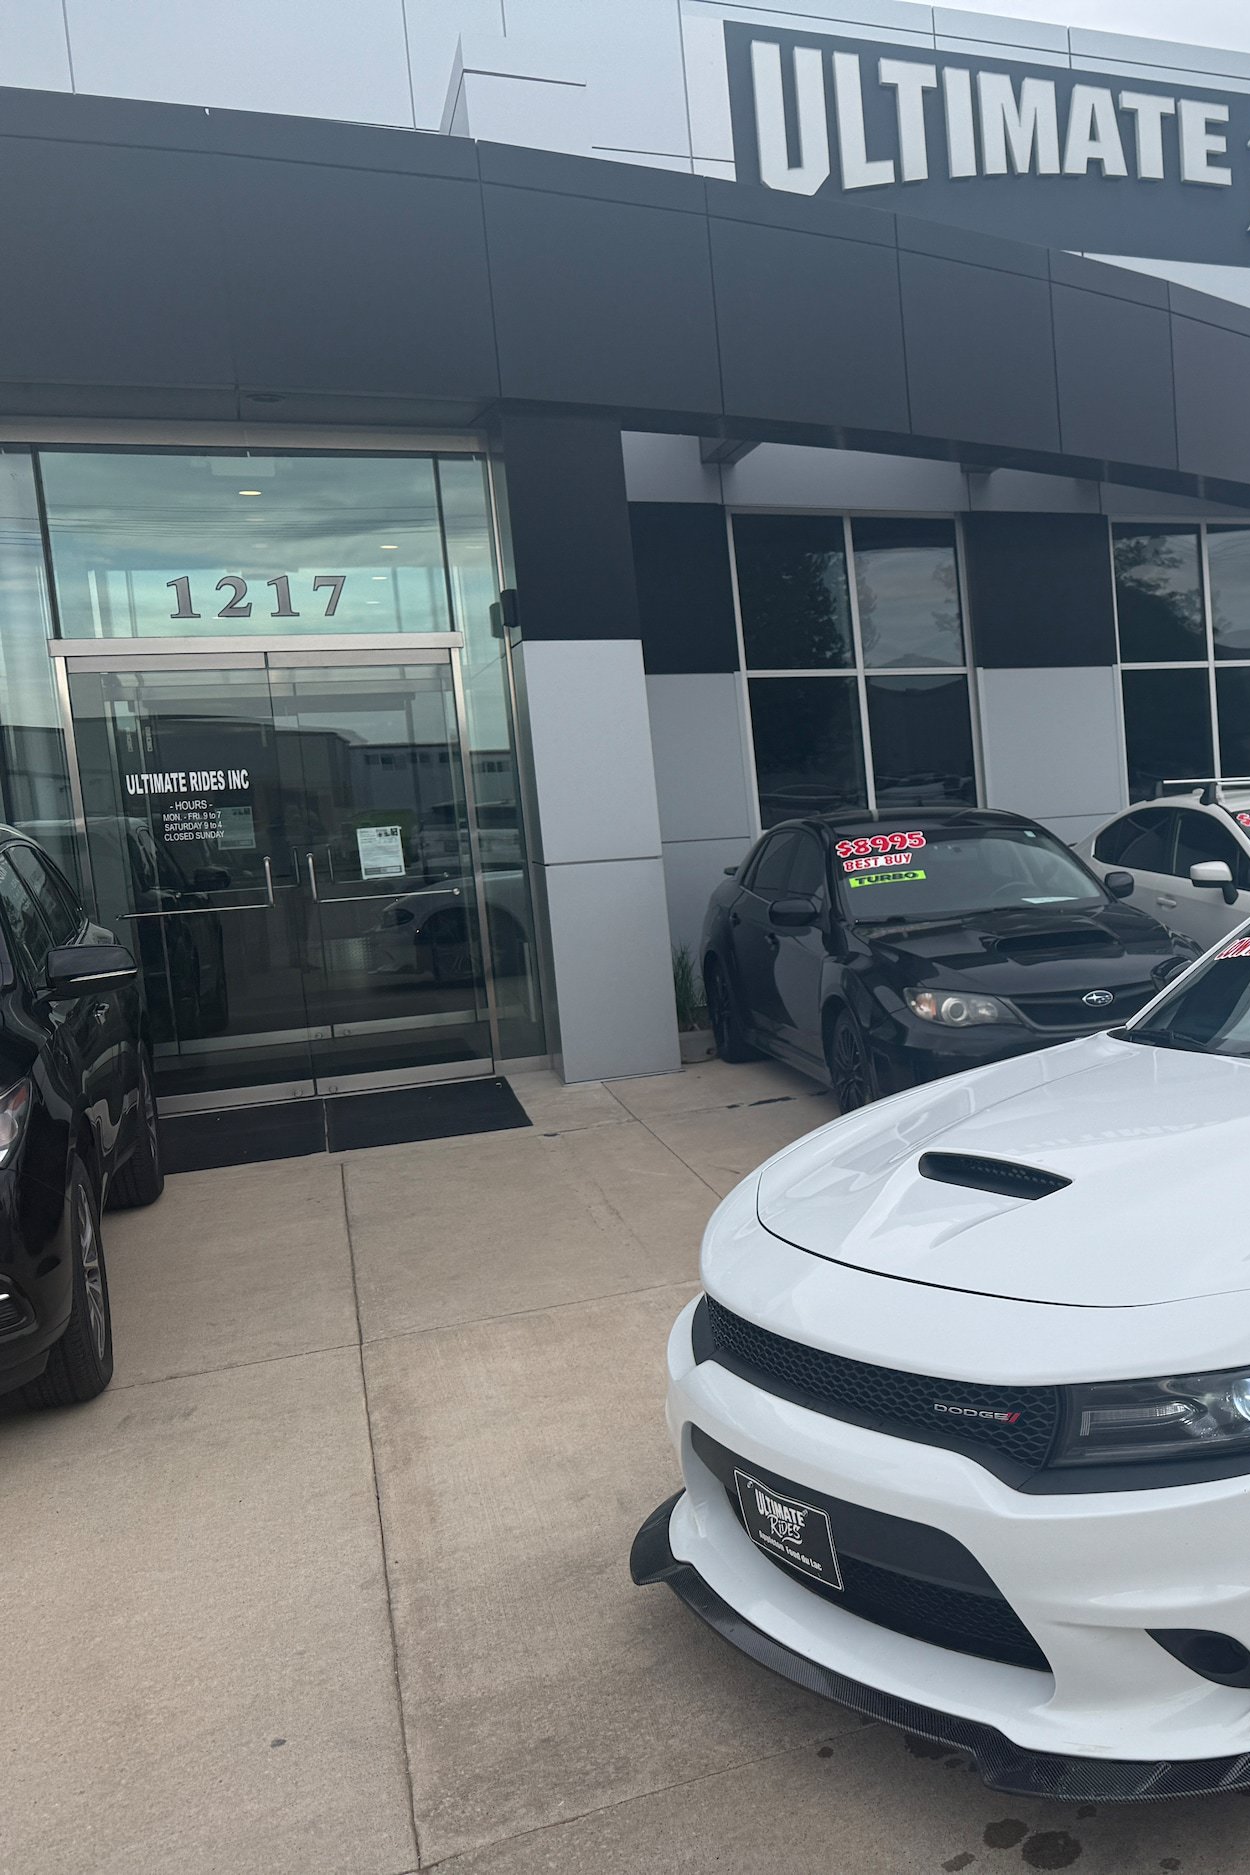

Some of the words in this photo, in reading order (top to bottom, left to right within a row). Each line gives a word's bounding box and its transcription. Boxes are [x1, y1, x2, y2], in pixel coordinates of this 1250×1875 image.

[749, 39, 1233, 197] ULTIMATE
[166, 575, 347, 619] 1217
[126, 771, 187, 795] ULTIMATE
[189, 770, 226, 792] RIDES
[228, 769, 250, 790] INC
[175, 800, 207, 811] HOURS
[163, 813, 183, 822] MON.
[187, 812, 202, 821] FRI.
[203, 812, 208, 820] 9
[209, 812, 216, 820] to
[217, 811, 222, 819] 7
[164, 822, 202, 832] SATURDAY
[204, 822, 209, 830] 9
[217, 820, 223, 828] 4
[164, 832, 194, 841] CLOSED
[196, 830, 225, 840] SUNDAY
[836, 830, 926, 858] $8995
[843, 856, 880, 873] BEST
[883, 853, 912, 866] BUY
[854, 871, 918, 885] TURBO
[934, 1403, 1009, 1421] DODGE
[755, 1488, 806, 1527] ULTIMATE
